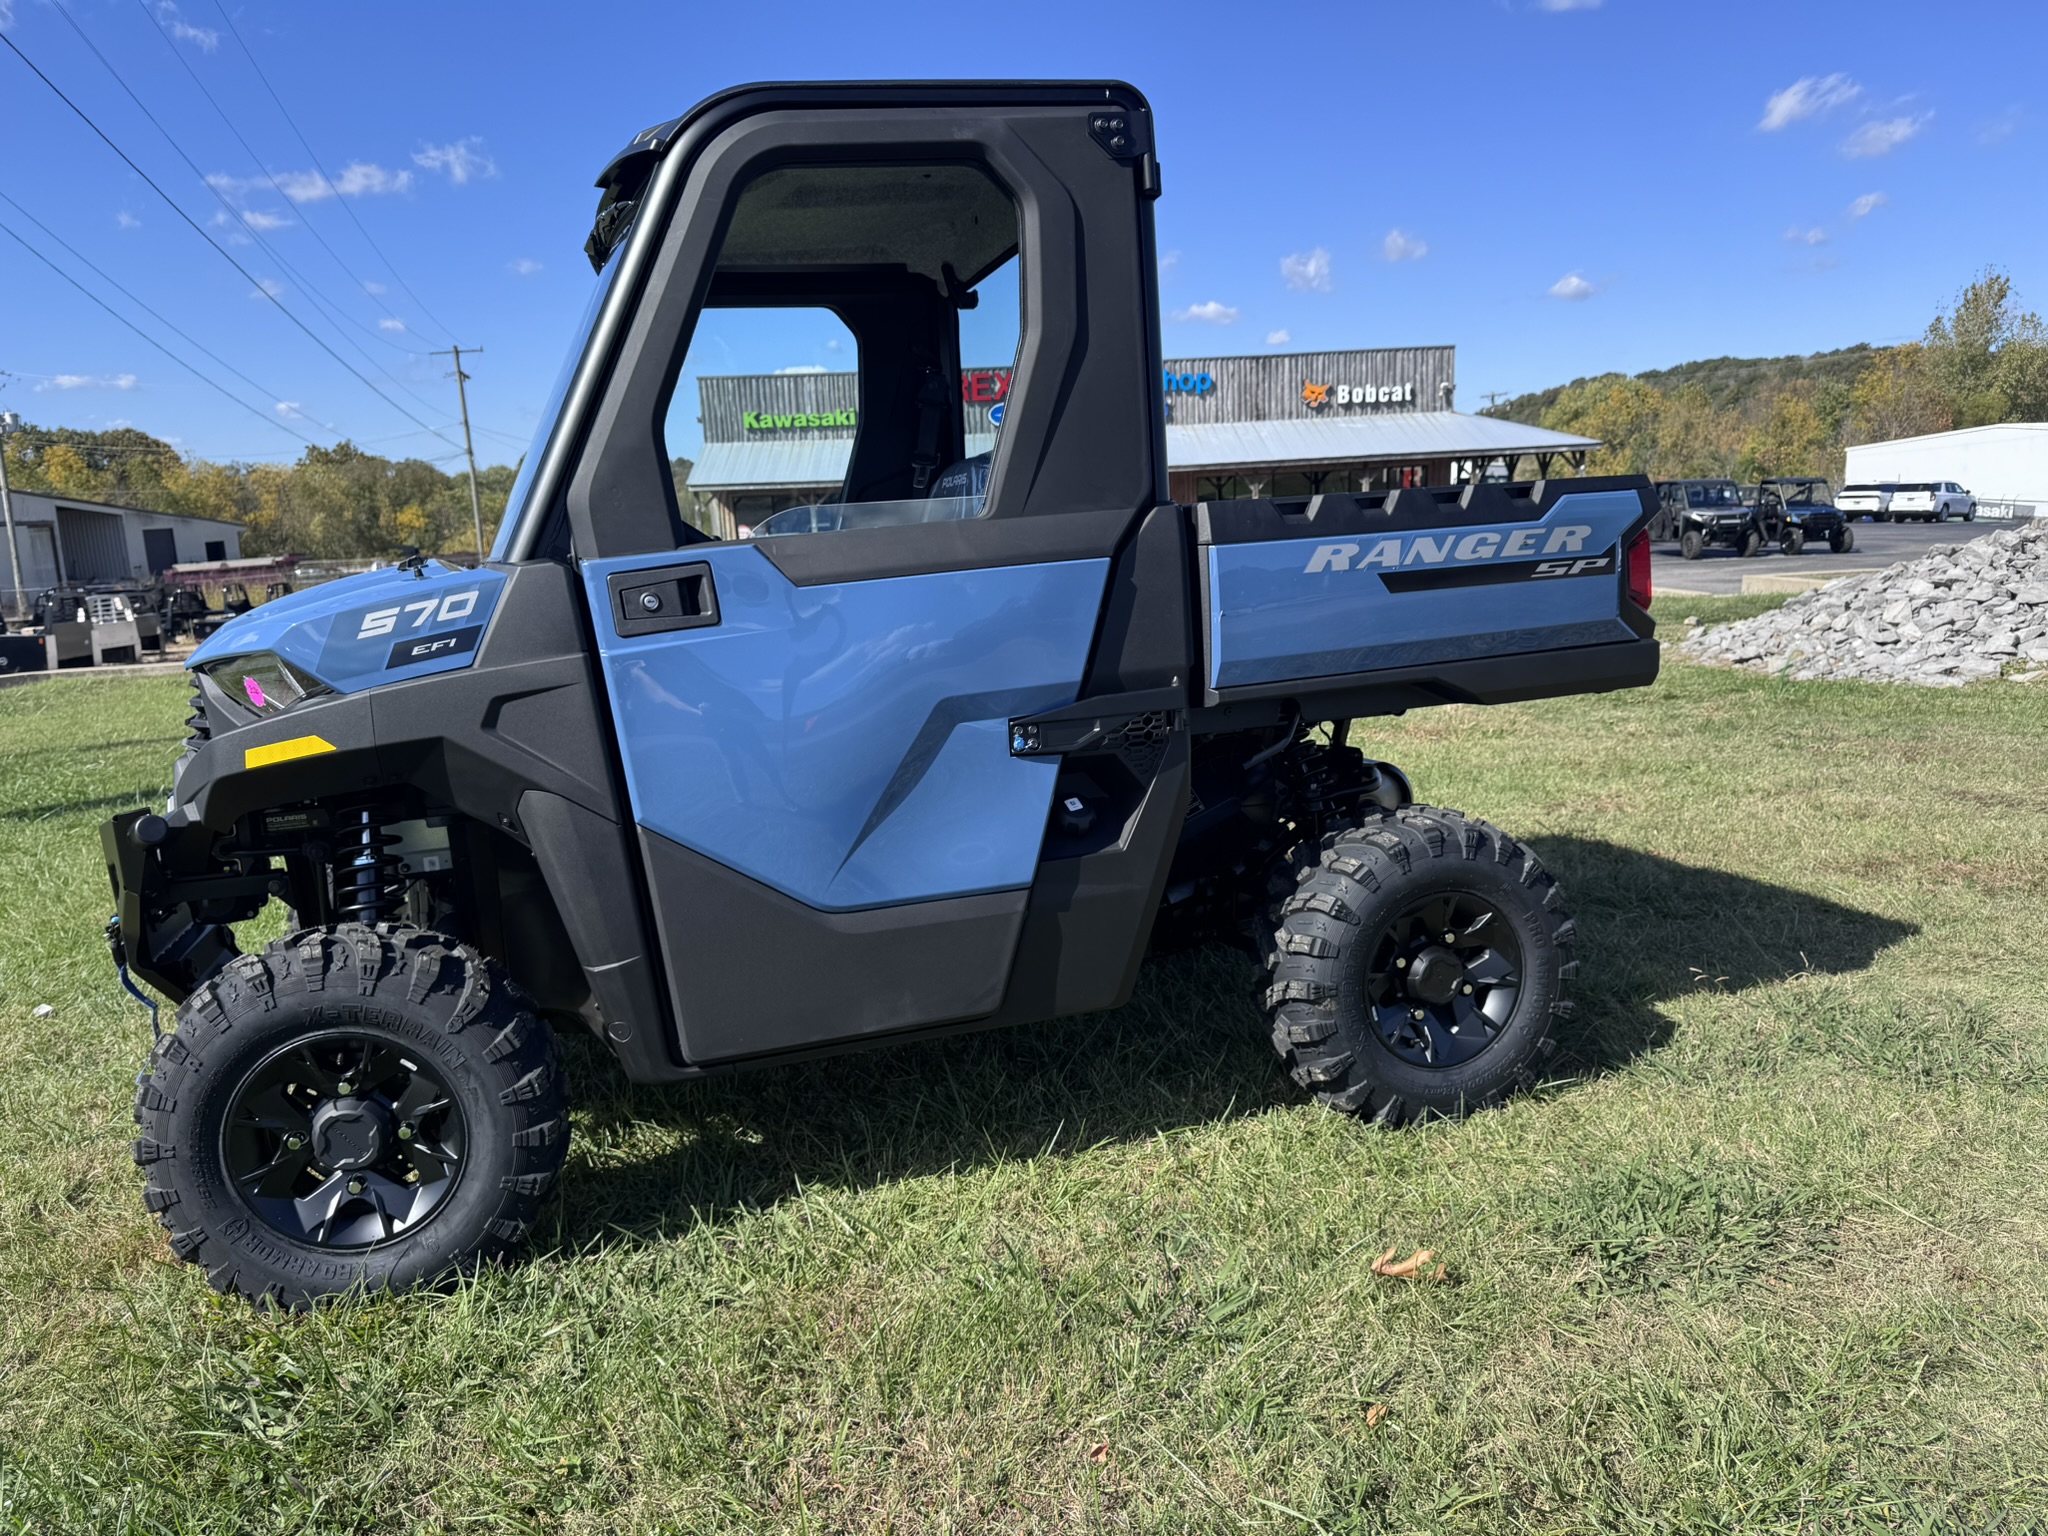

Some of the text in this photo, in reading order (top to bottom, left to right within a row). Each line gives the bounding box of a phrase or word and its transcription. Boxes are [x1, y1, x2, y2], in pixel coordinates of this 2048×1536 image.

[1337, 383, 1412, 404] Bobcat
[743, 407, 856, 429] Kawasaki
[942, 472, 967, 489] POLARIS
[1303, 524, 1593, 575] RANGER
[1531, 557, 1611, 579] SP
[411, 638, 457, 656] EFI
[265, 814, 308, 823] POLARIS
[304, 1003, 467, 1070] X-TERRAIN
[241, 1231, 321, 1278] ARMOR
